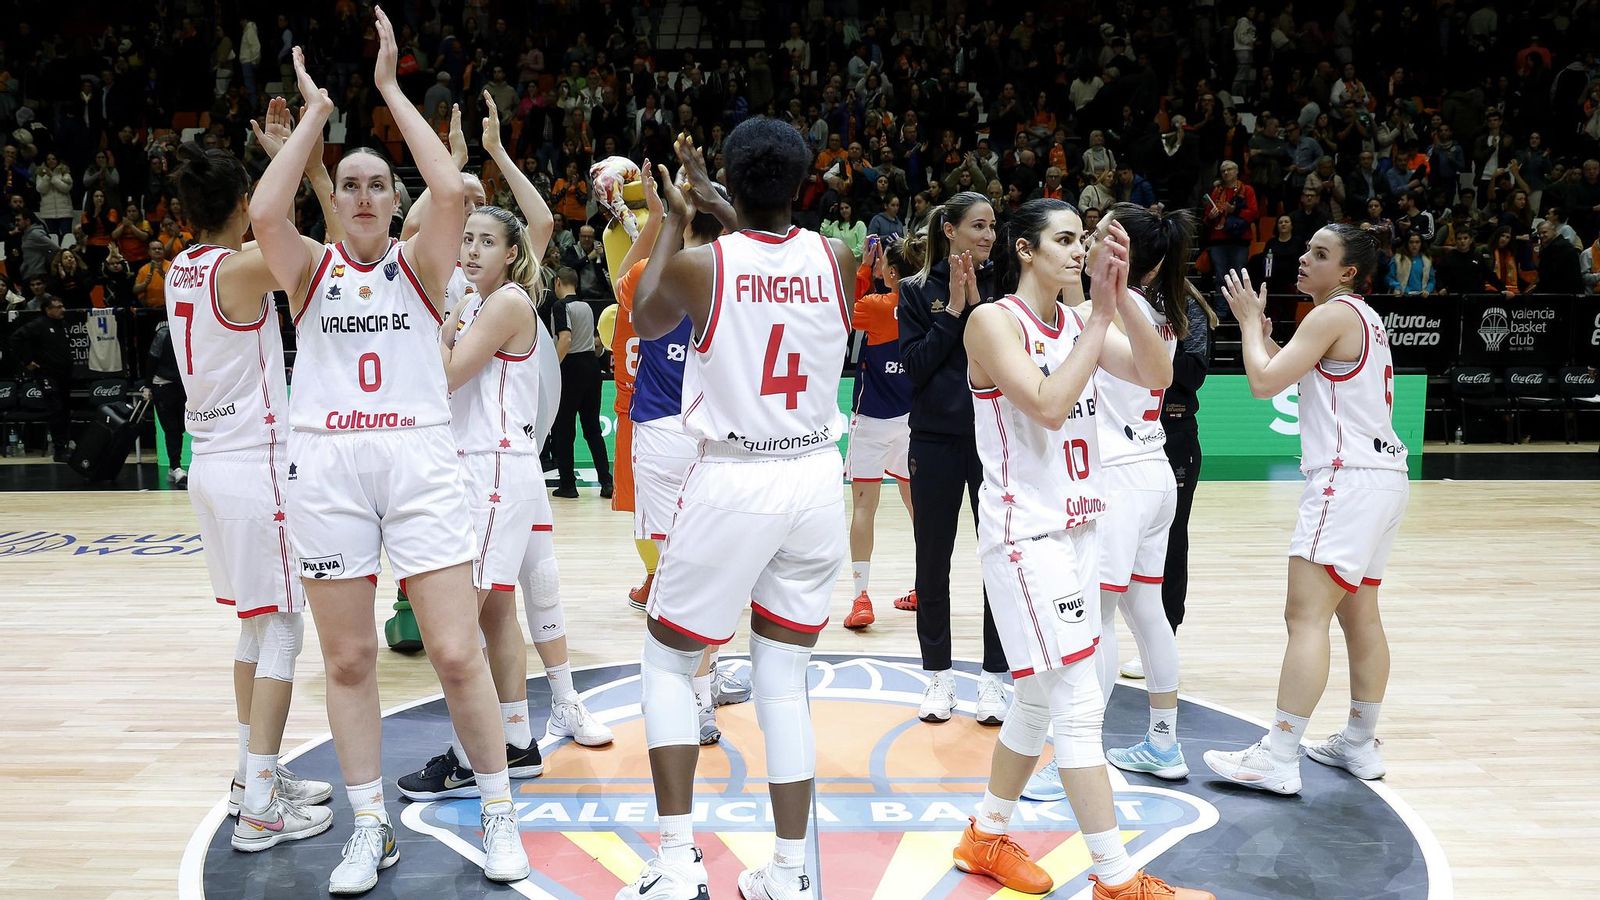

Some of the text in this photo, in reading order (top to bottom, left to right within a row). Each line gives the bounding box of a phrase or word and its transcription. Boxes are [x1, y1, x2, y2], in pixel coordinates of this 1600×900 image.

[736, 274, 830, 303] FINGALL
[1380, 312, 1441, 328] ultura del
[1511, 307, 1555, 319] valencia
[70, 322, 88, 334] vale
[321, 313, 411, 333] VALENCIA BC
[1511, 320, 1547, 333] basket
[175, 302, 194, 376] 7
[1387, 329, 1441, 346] fuerzo
[1509, 334, 1535, 346] club
[358, 351, 383, 393] 0
[760, 323, 809, 411] 4
[325, 409, 416, 430] Cultura del
[1062, 438, 1090, 482] 10
[1066, 495, 1101, 516] Cultura
[92, 533, 203, 544] EU
[73, 545, 204, 556] WO
[302, 560, 341, 572] PULEVA
[870, 801, 1144, 822] BAKT
